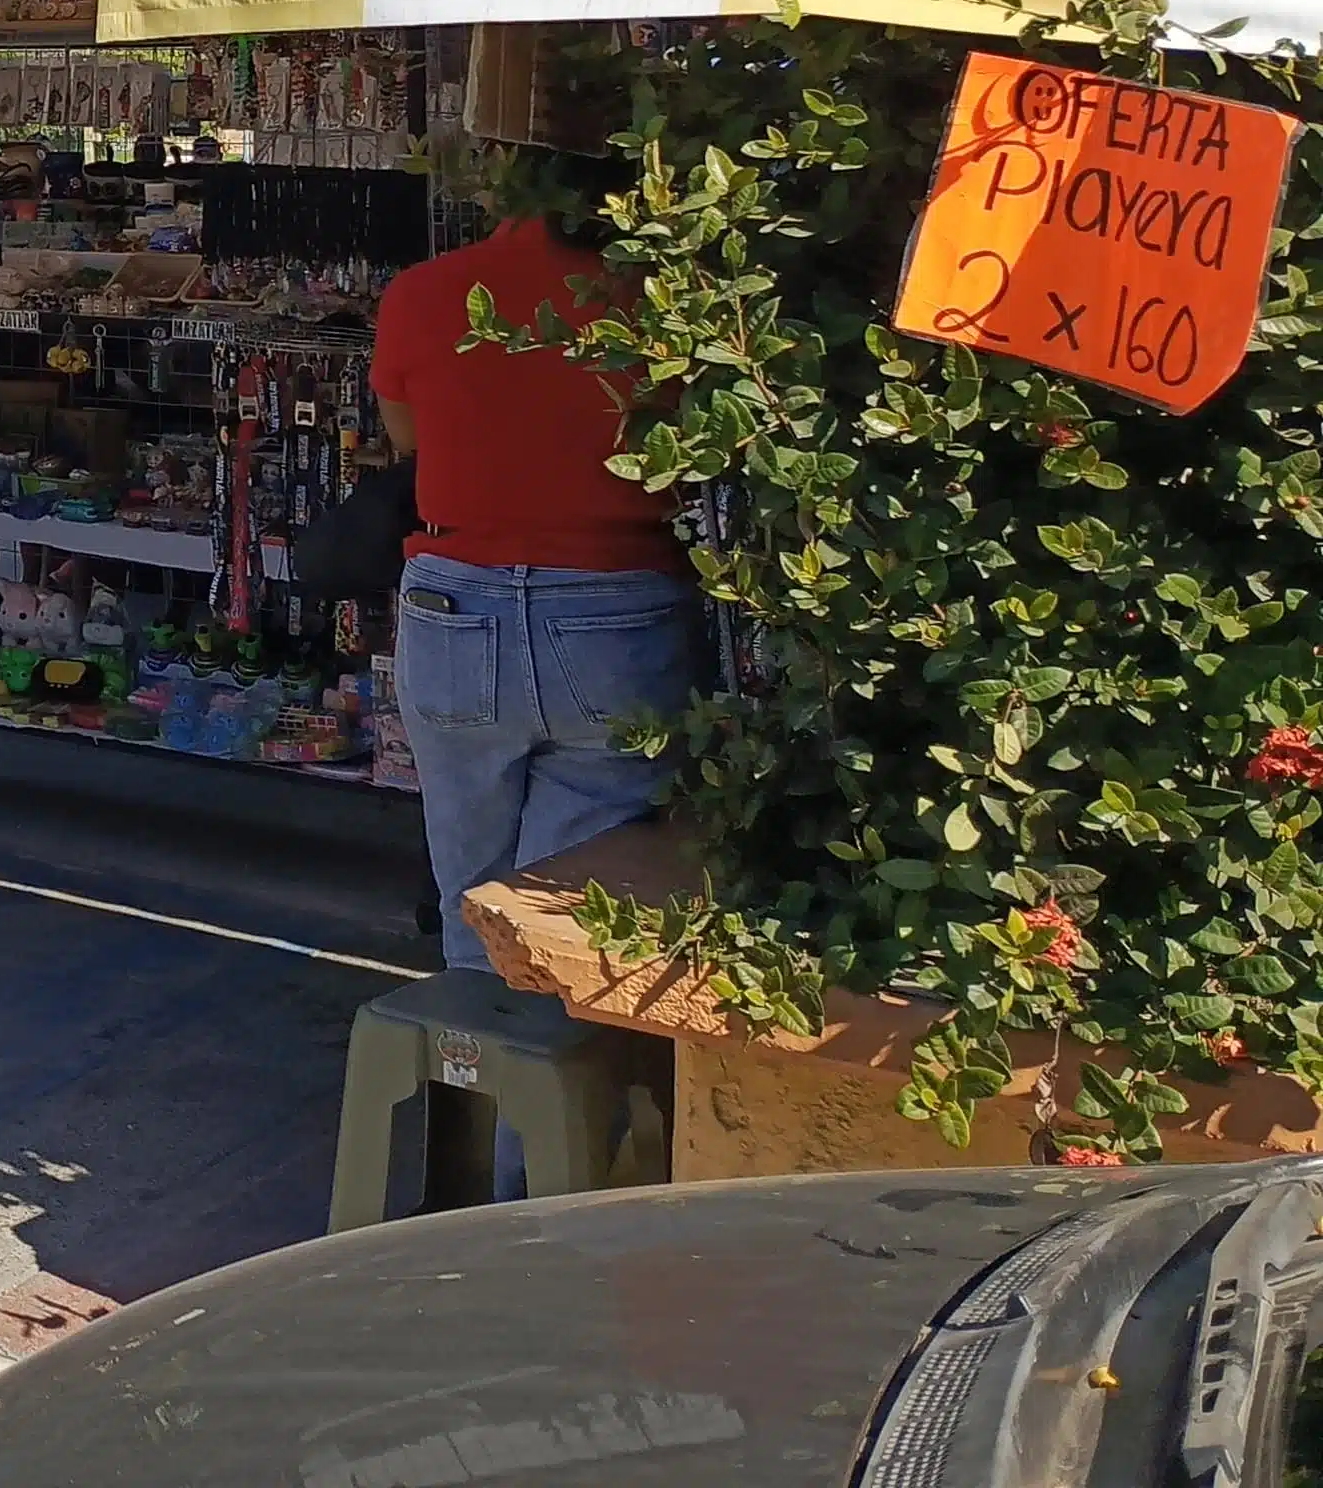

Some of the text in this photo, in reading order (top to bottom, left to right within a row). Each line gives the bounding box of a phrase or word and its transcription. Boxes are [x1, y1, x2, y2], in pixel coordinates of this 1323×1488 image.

[1014, 68, 1230, 171] OFERTA
[933, 250, 1010, 343] 2
[1108, 285, 1198, 387] 160
